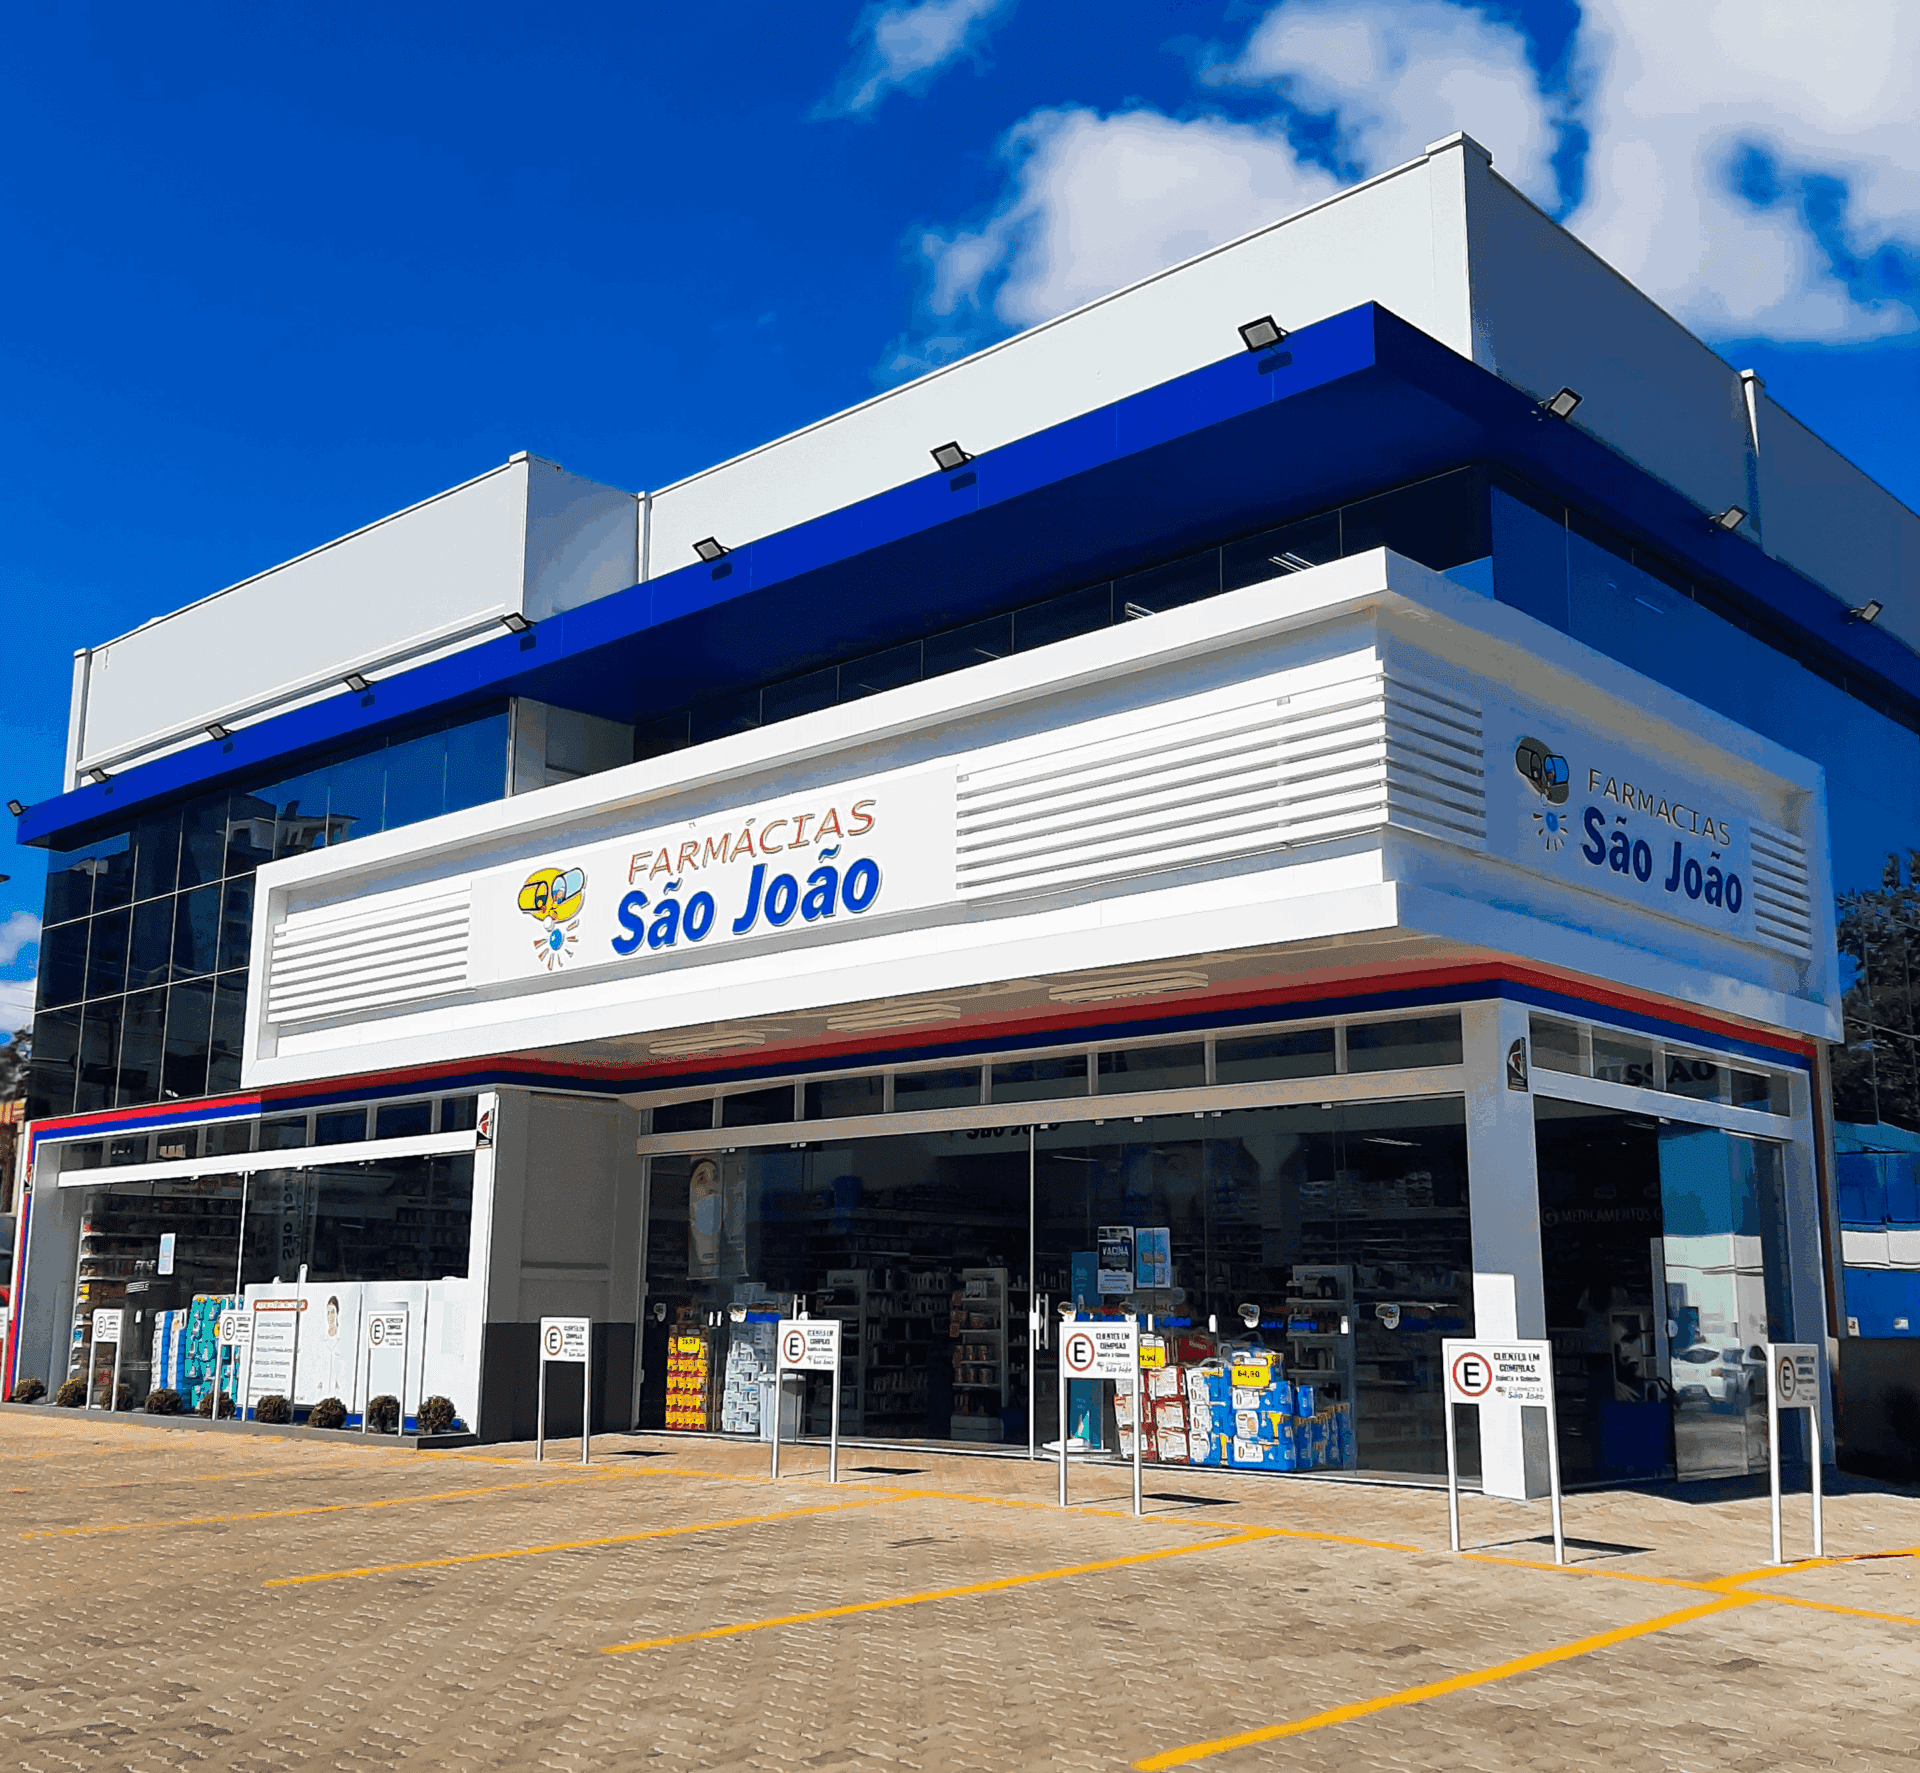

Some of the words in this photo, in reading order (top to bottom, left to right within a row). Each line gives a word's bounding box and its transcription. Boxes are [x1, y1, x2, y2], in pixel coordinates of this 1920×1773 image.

[1588, 768, 1731, 846] FARMÁCIAS
[628, 799, 876, 884] FARMÁCIAS
[1582, 806, 1652, 882] São
[1665, 841, 1742, 914] João
[611, 877, 689, 955] São
[732, 844, 883, 935] João
[550, 1332, 557, 1349] E
[789, 1337, 800, 1356] E
[1073, 1341, 1087, 1363] E
[1463, 1362, 1481, 1387] E
